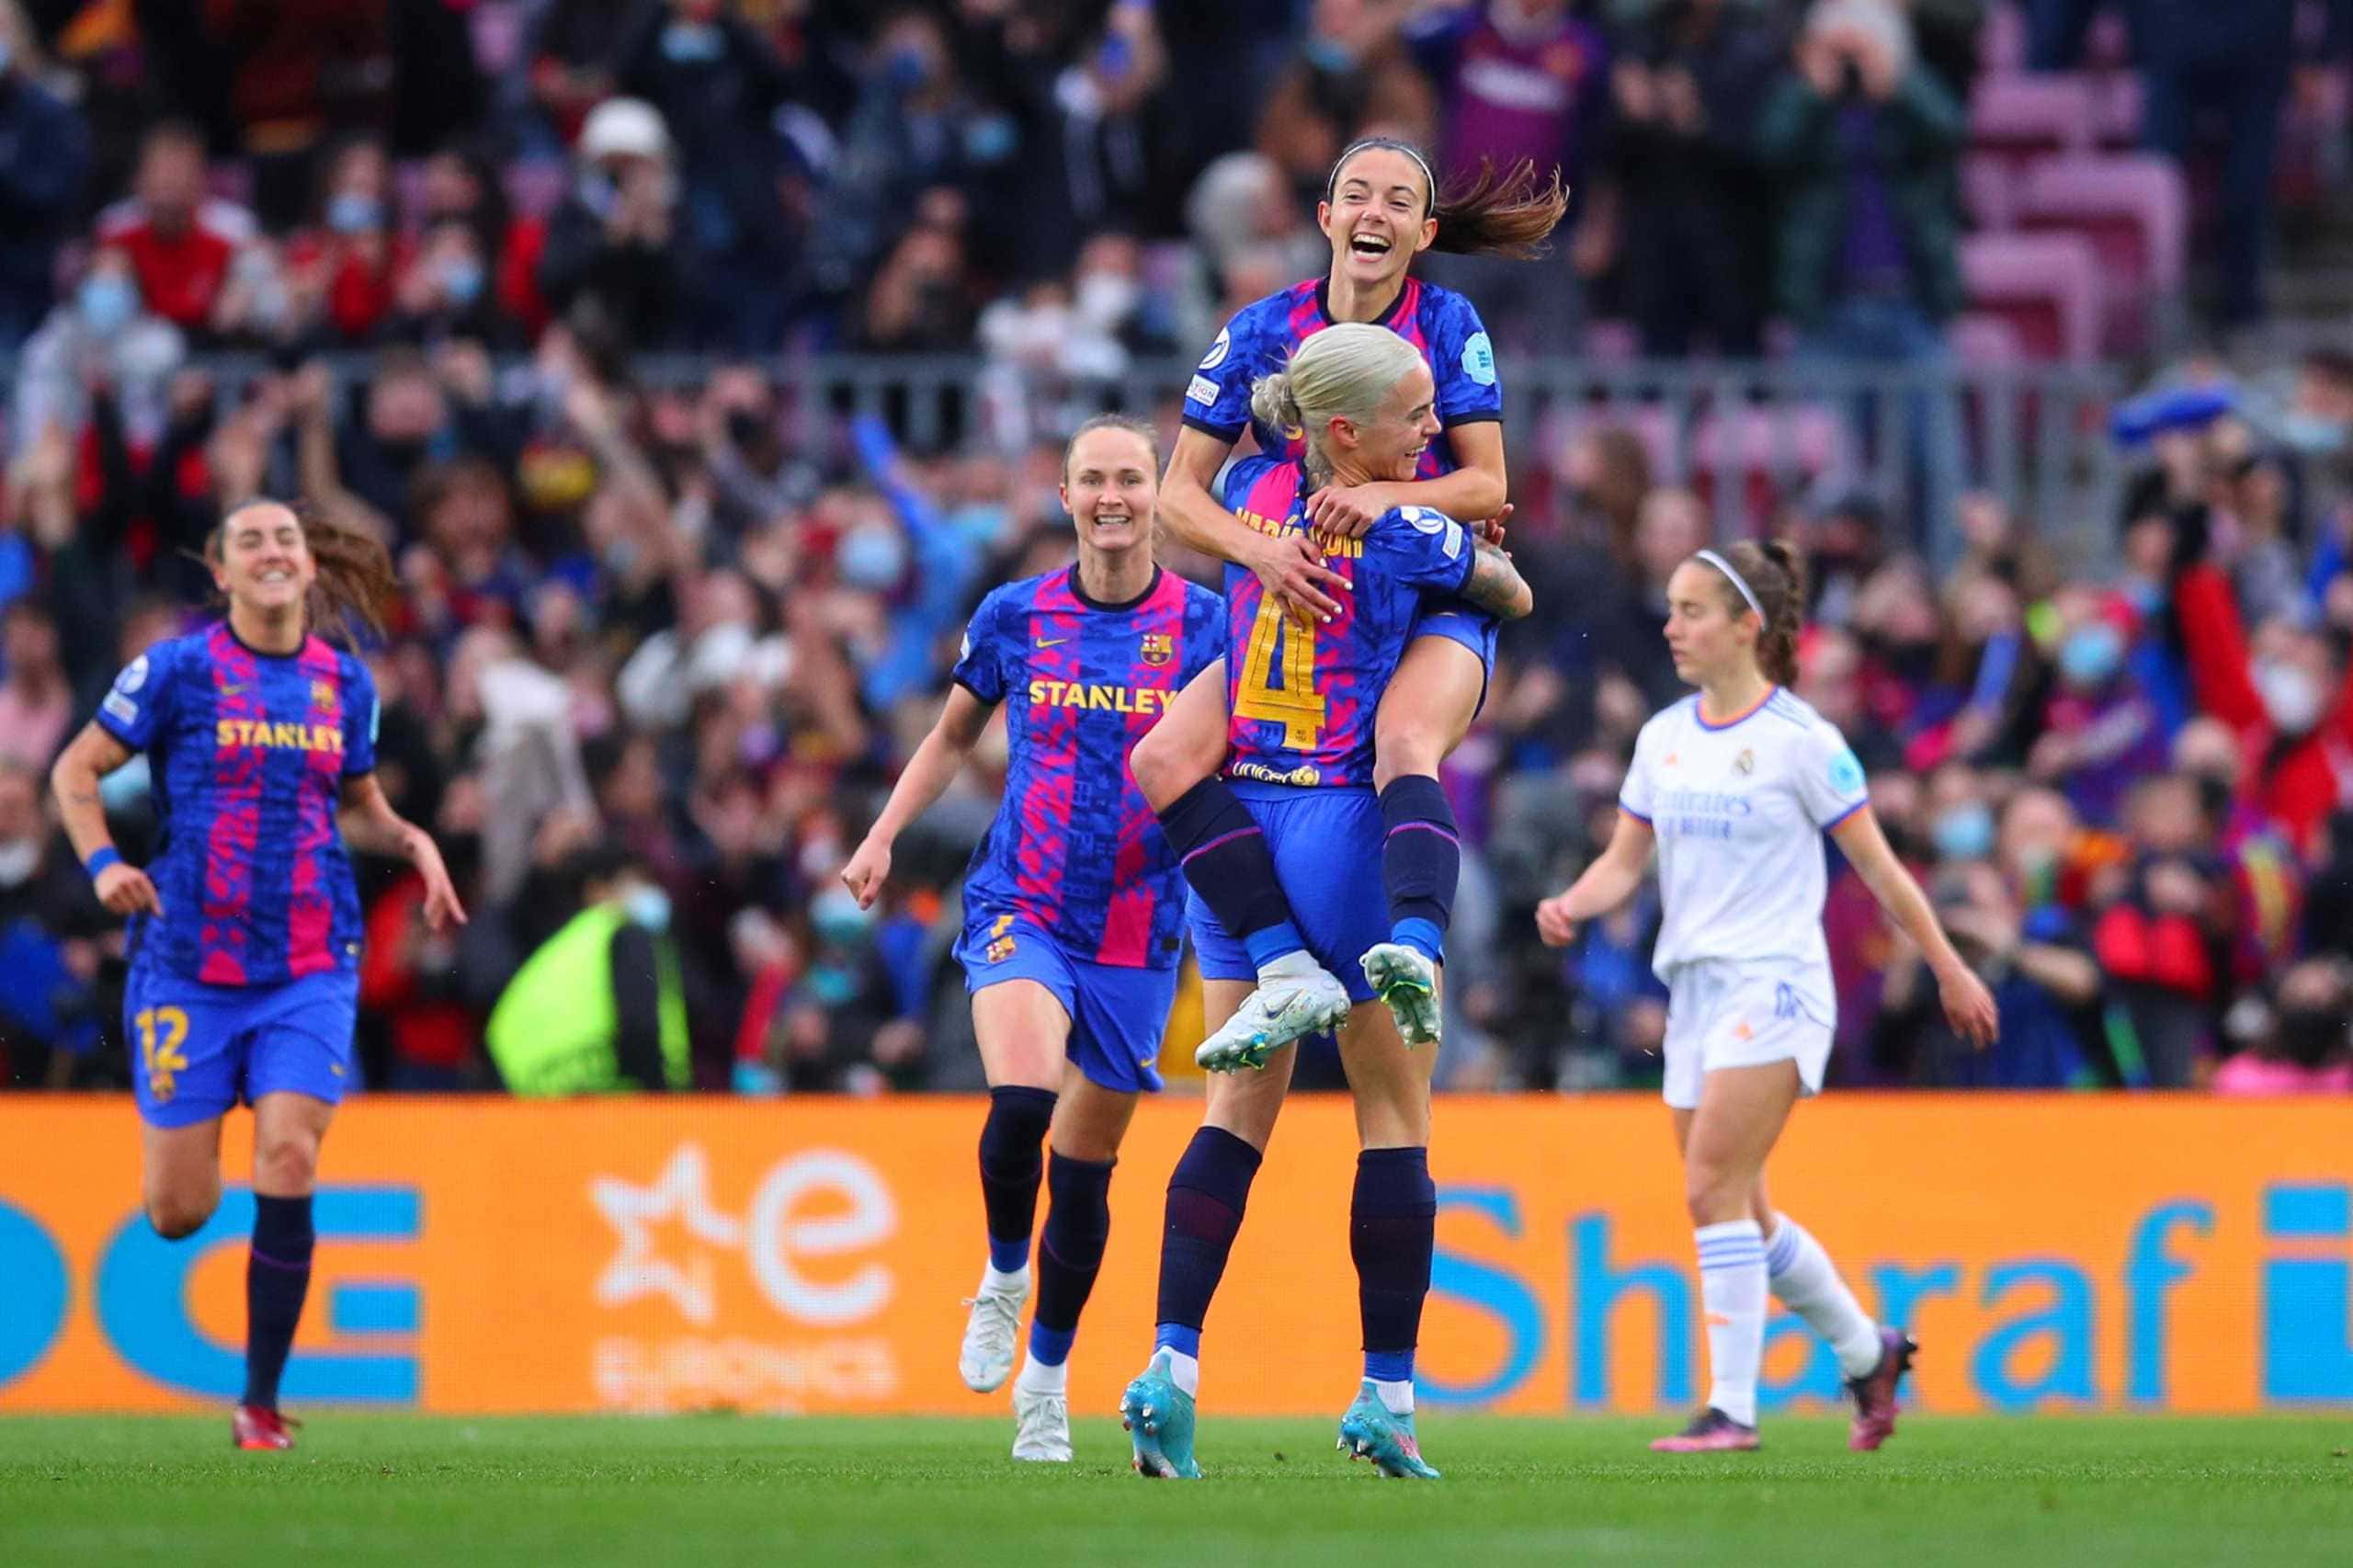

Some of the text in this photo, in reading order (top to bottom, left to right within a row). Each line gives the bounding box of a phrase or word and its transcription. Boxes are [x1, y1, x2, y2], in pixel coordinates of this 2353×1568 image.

[1233, 589, 1325, 750] 4
[1029, 680, 1177, 714] STANLEY
[217, 719, 342, 753] STANLEY
[135, 1006, 189, 1072] 12
